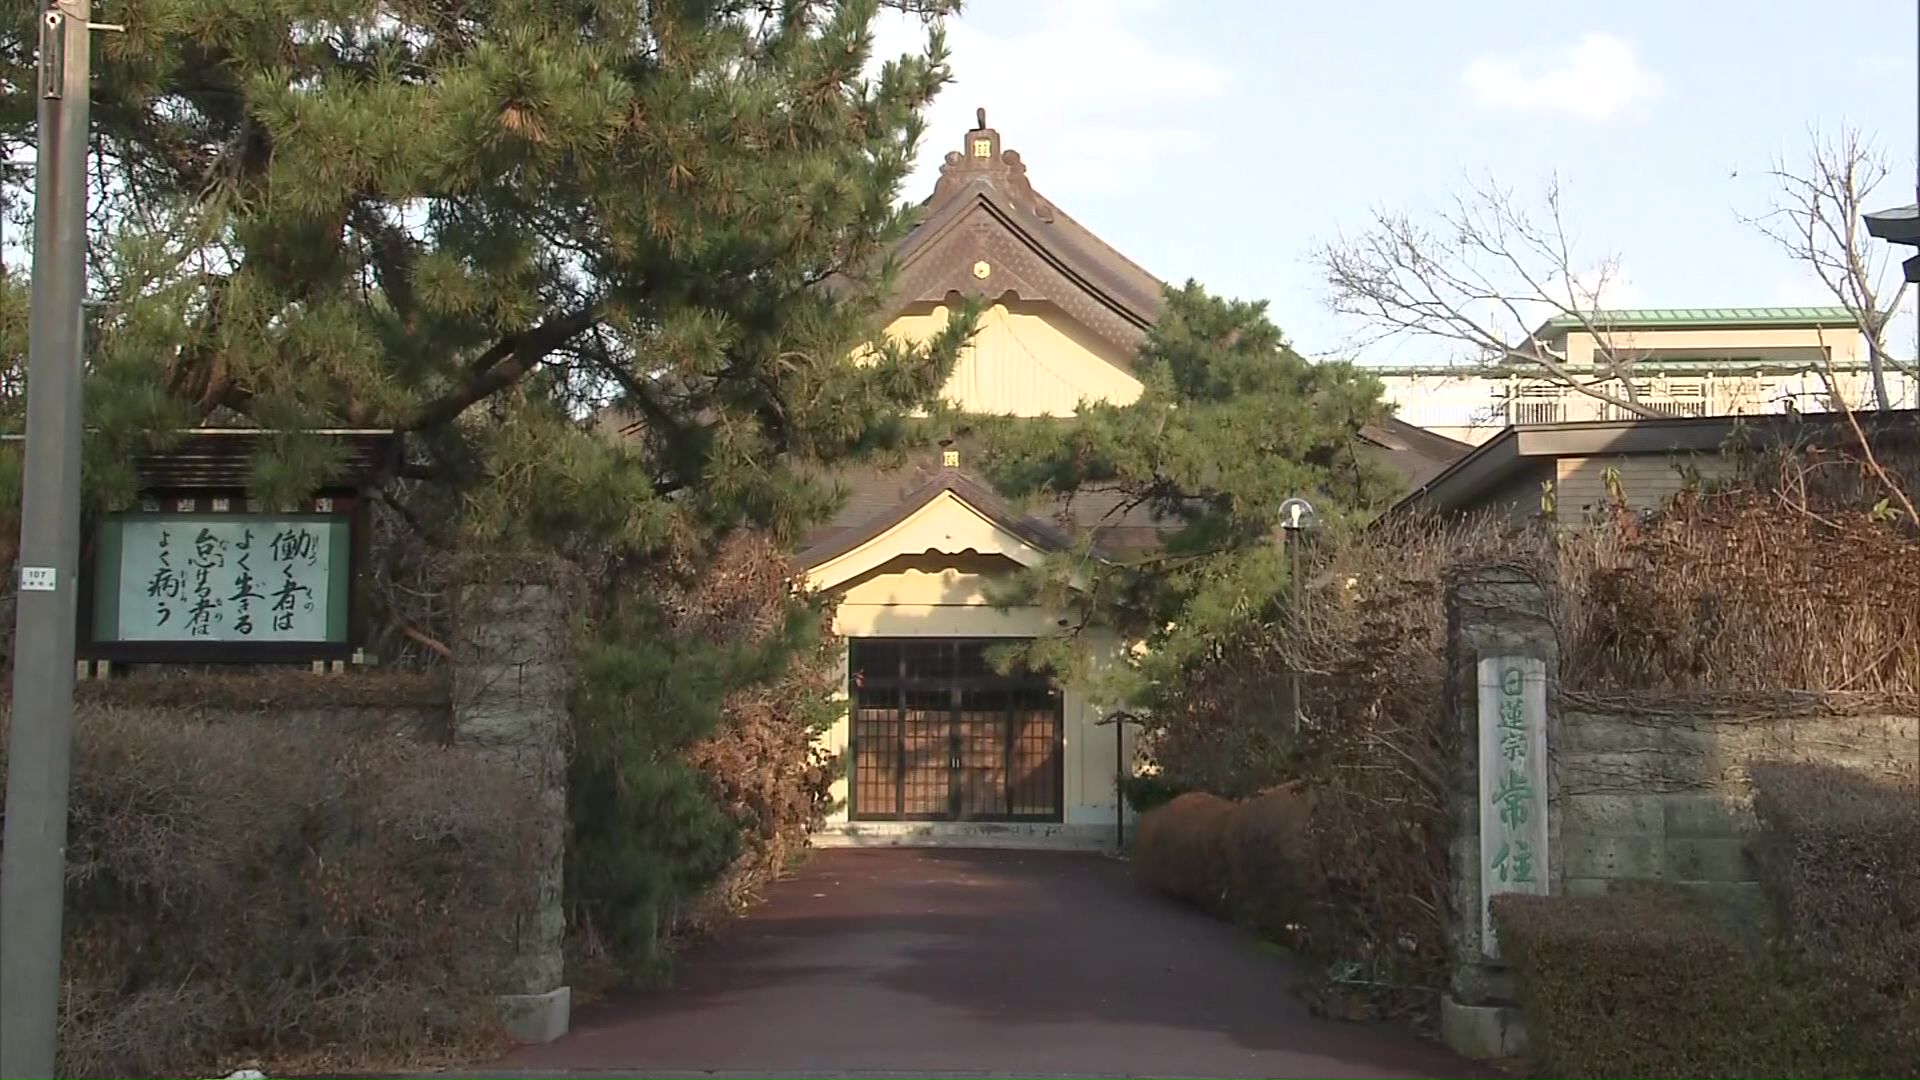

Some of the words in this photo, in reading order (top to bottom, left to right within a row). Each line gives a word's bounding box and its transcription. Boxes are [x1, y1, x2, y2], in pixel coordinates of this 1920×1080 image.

[28, 570, 47, 579] 107
[147, 530, 180, 627] よく病う
[184, 527, 218, 636] 怠ける者は
[228, 528, 265, 635] よく生きる
[270, 528, 311, 632] 働く者は
